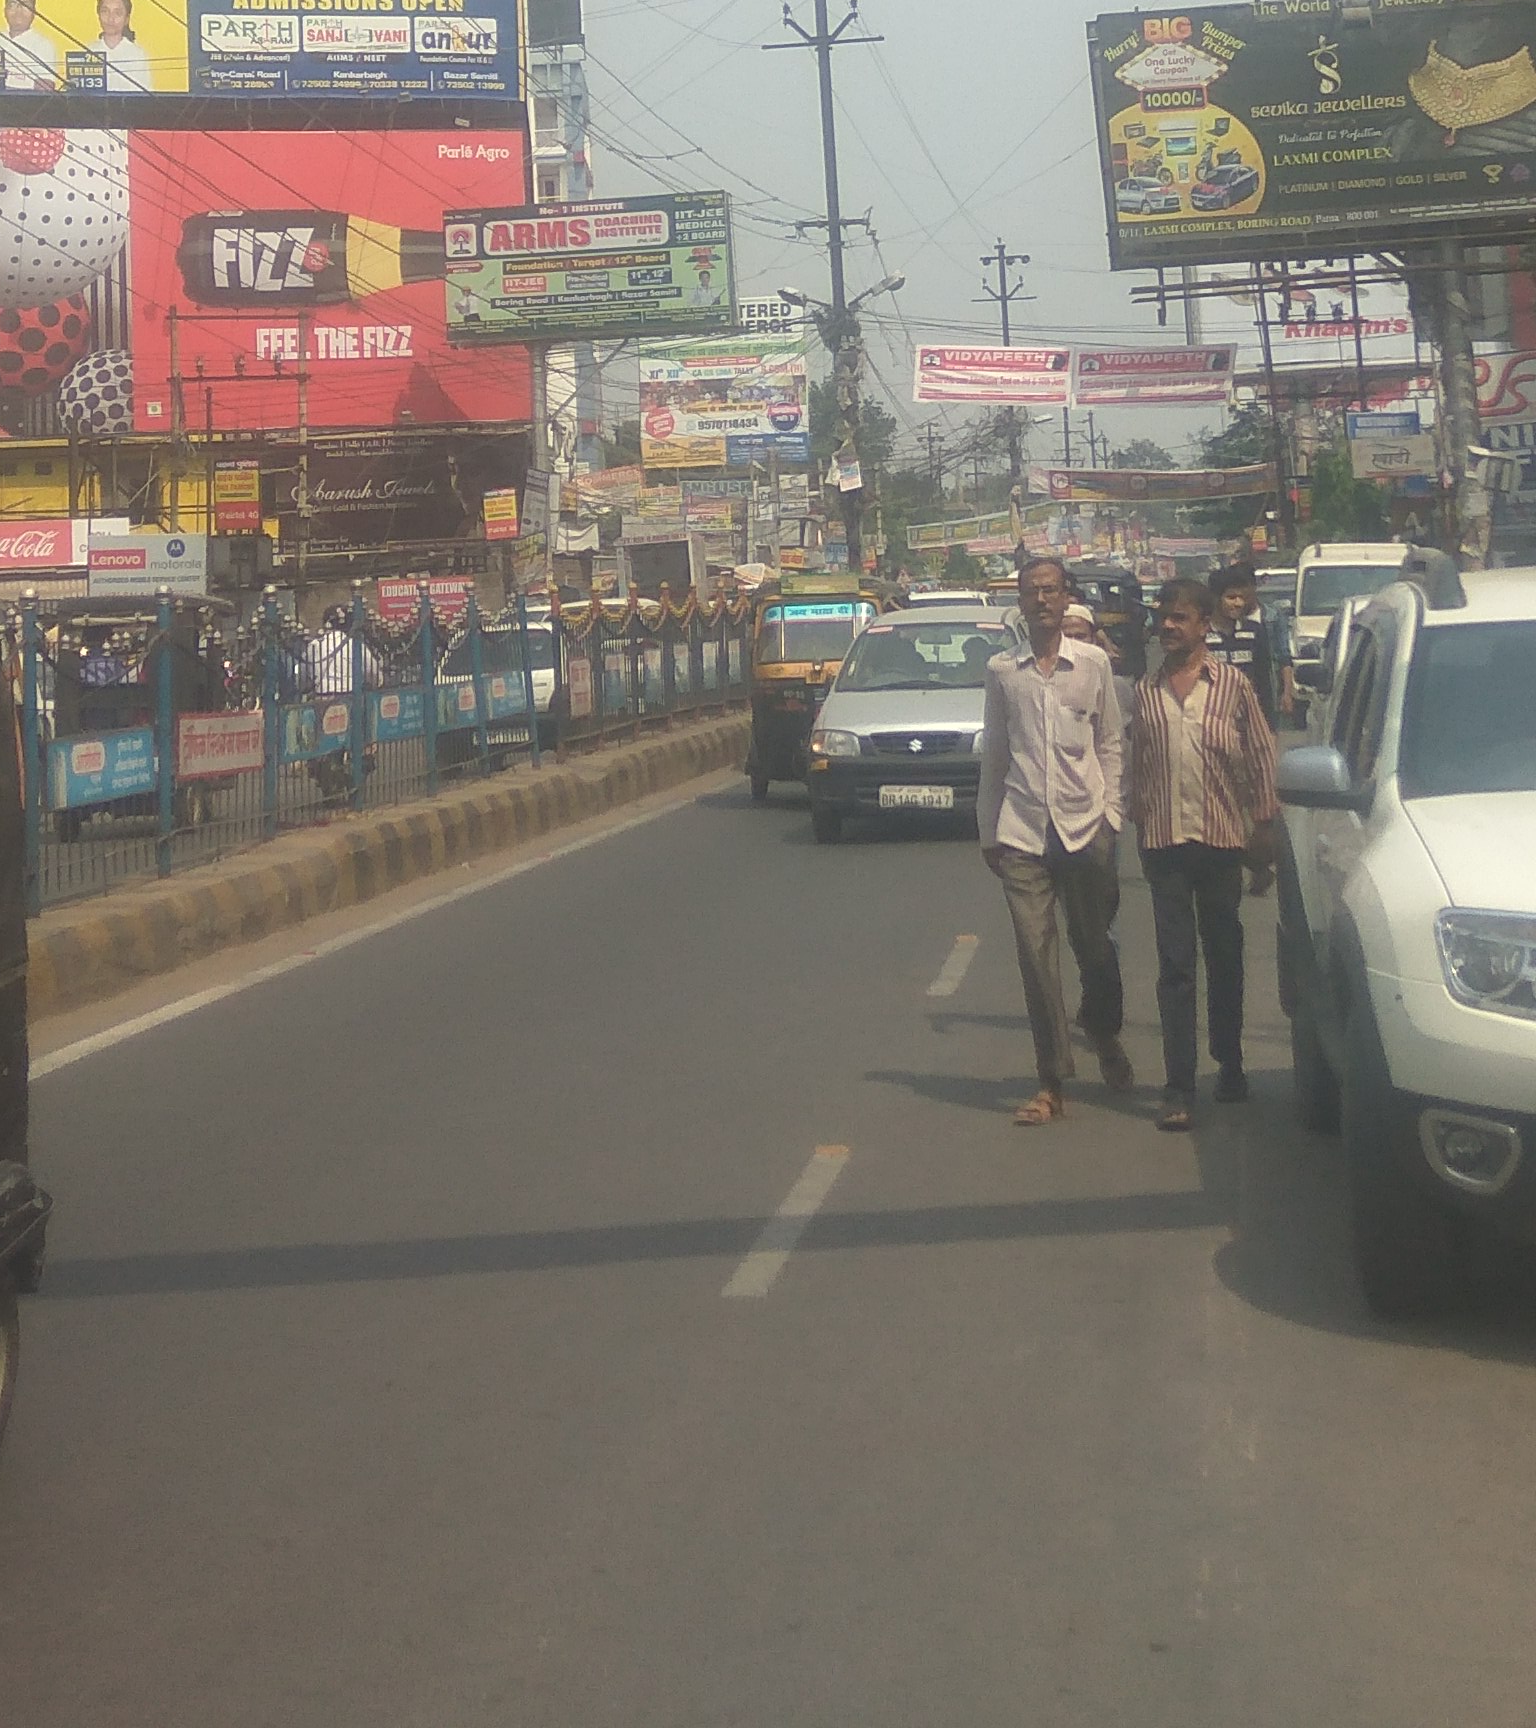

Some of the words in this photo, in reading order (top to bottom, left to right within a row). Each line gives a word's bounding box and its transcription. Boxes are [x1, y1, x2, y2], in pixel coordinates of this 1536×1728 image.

[1144, 17, 1192, 43] BIG
[476, 145, 509, 161] Agro
[1274, 151, 1318, 166] LAXMI
[1322, 147, 1392, 162] COMPLEX
[1396, 175, 1423, 185] GOLD
[594, 214, 662, 228] COACHING
[675, 220, 725, 230] MEDICAL
[490, 220, 591, 252] ARMS
[595, 224, 662, 238] INSTITUTE
[691, 230, 725, 240] BOARD
[212, 228, 316, 291] FIZZ
[316, 328, 359, 357] THE
[363, 326, 412, 357] FIZZ
[944, 351, 1045, 362] VIDYAPEETH
[1103, 353, 1206, 365] VIDYAPEETH
[90, 553, 142, 567] Lenovo
[150, 556, 201, 570] motorola
